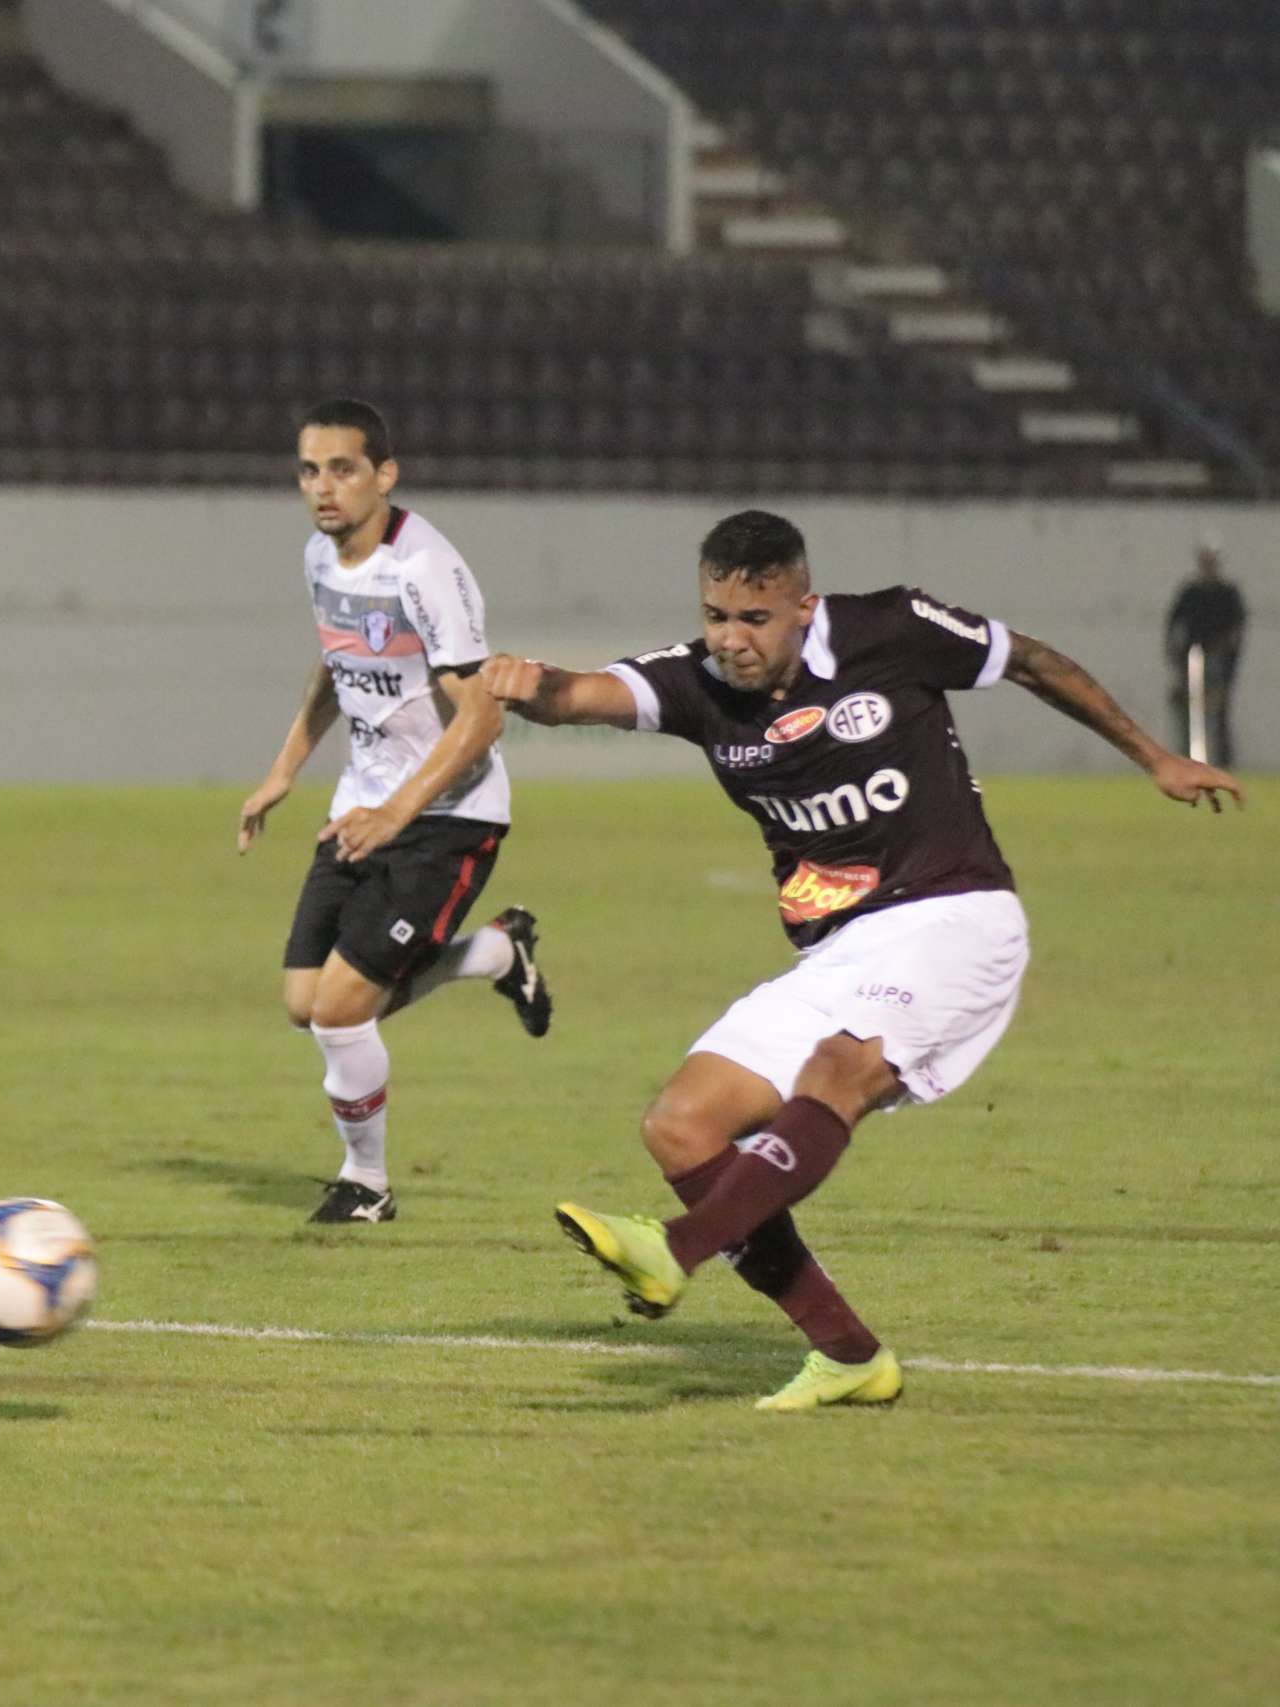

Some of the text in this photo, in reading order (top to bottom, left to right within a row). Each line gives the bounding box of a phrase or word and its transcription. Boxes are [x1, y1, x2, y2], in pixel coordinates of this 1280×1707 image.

[833, 699, 884, 736] AFE
[713, 742, 774, 762] LUPO
[856, 983, 914, 1005] LUPO
